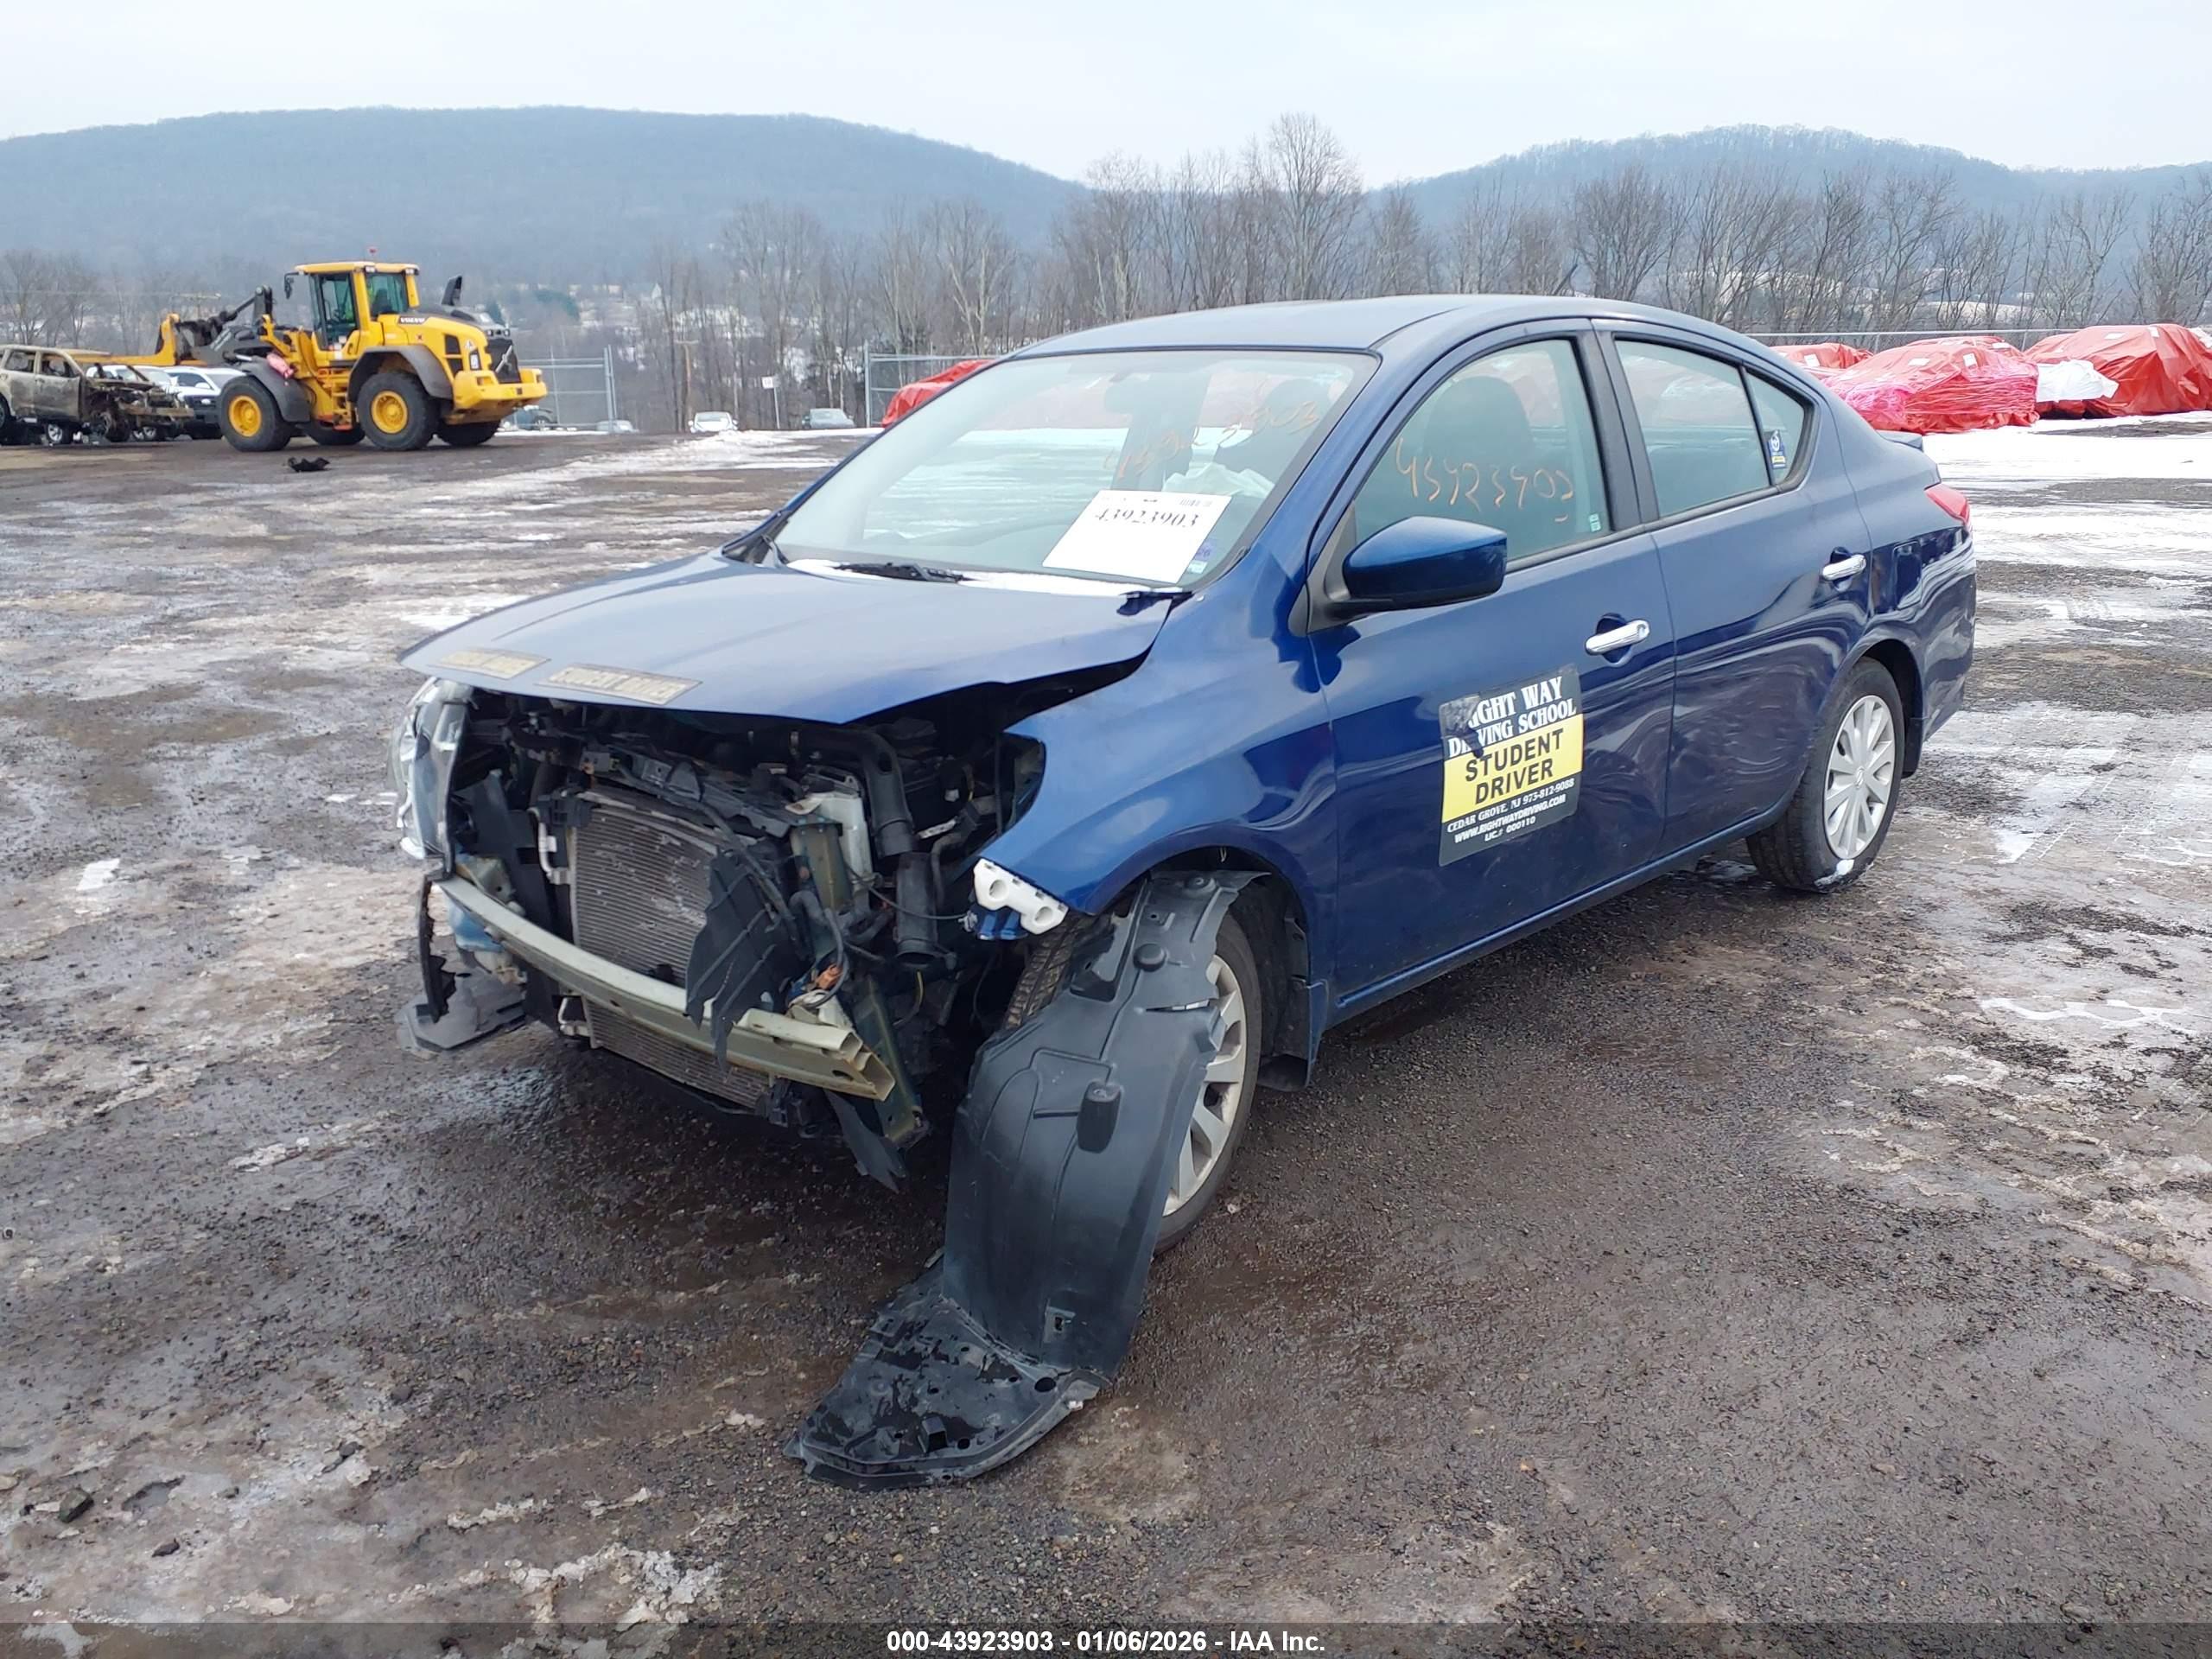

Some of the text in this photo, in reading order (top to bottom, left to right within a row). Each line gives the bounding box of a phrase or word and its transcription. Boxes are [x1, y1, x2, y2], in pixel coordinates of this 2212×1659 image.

[1095, 508, 1199, 527] 43923903
[1521, 676, 1563, 710] WAY
[1518, 698, 1577, 734] SCHOOL
[1465, 728, 1564, 782] STUDENT
[1475, 758, 1554, 804] DRIVER
